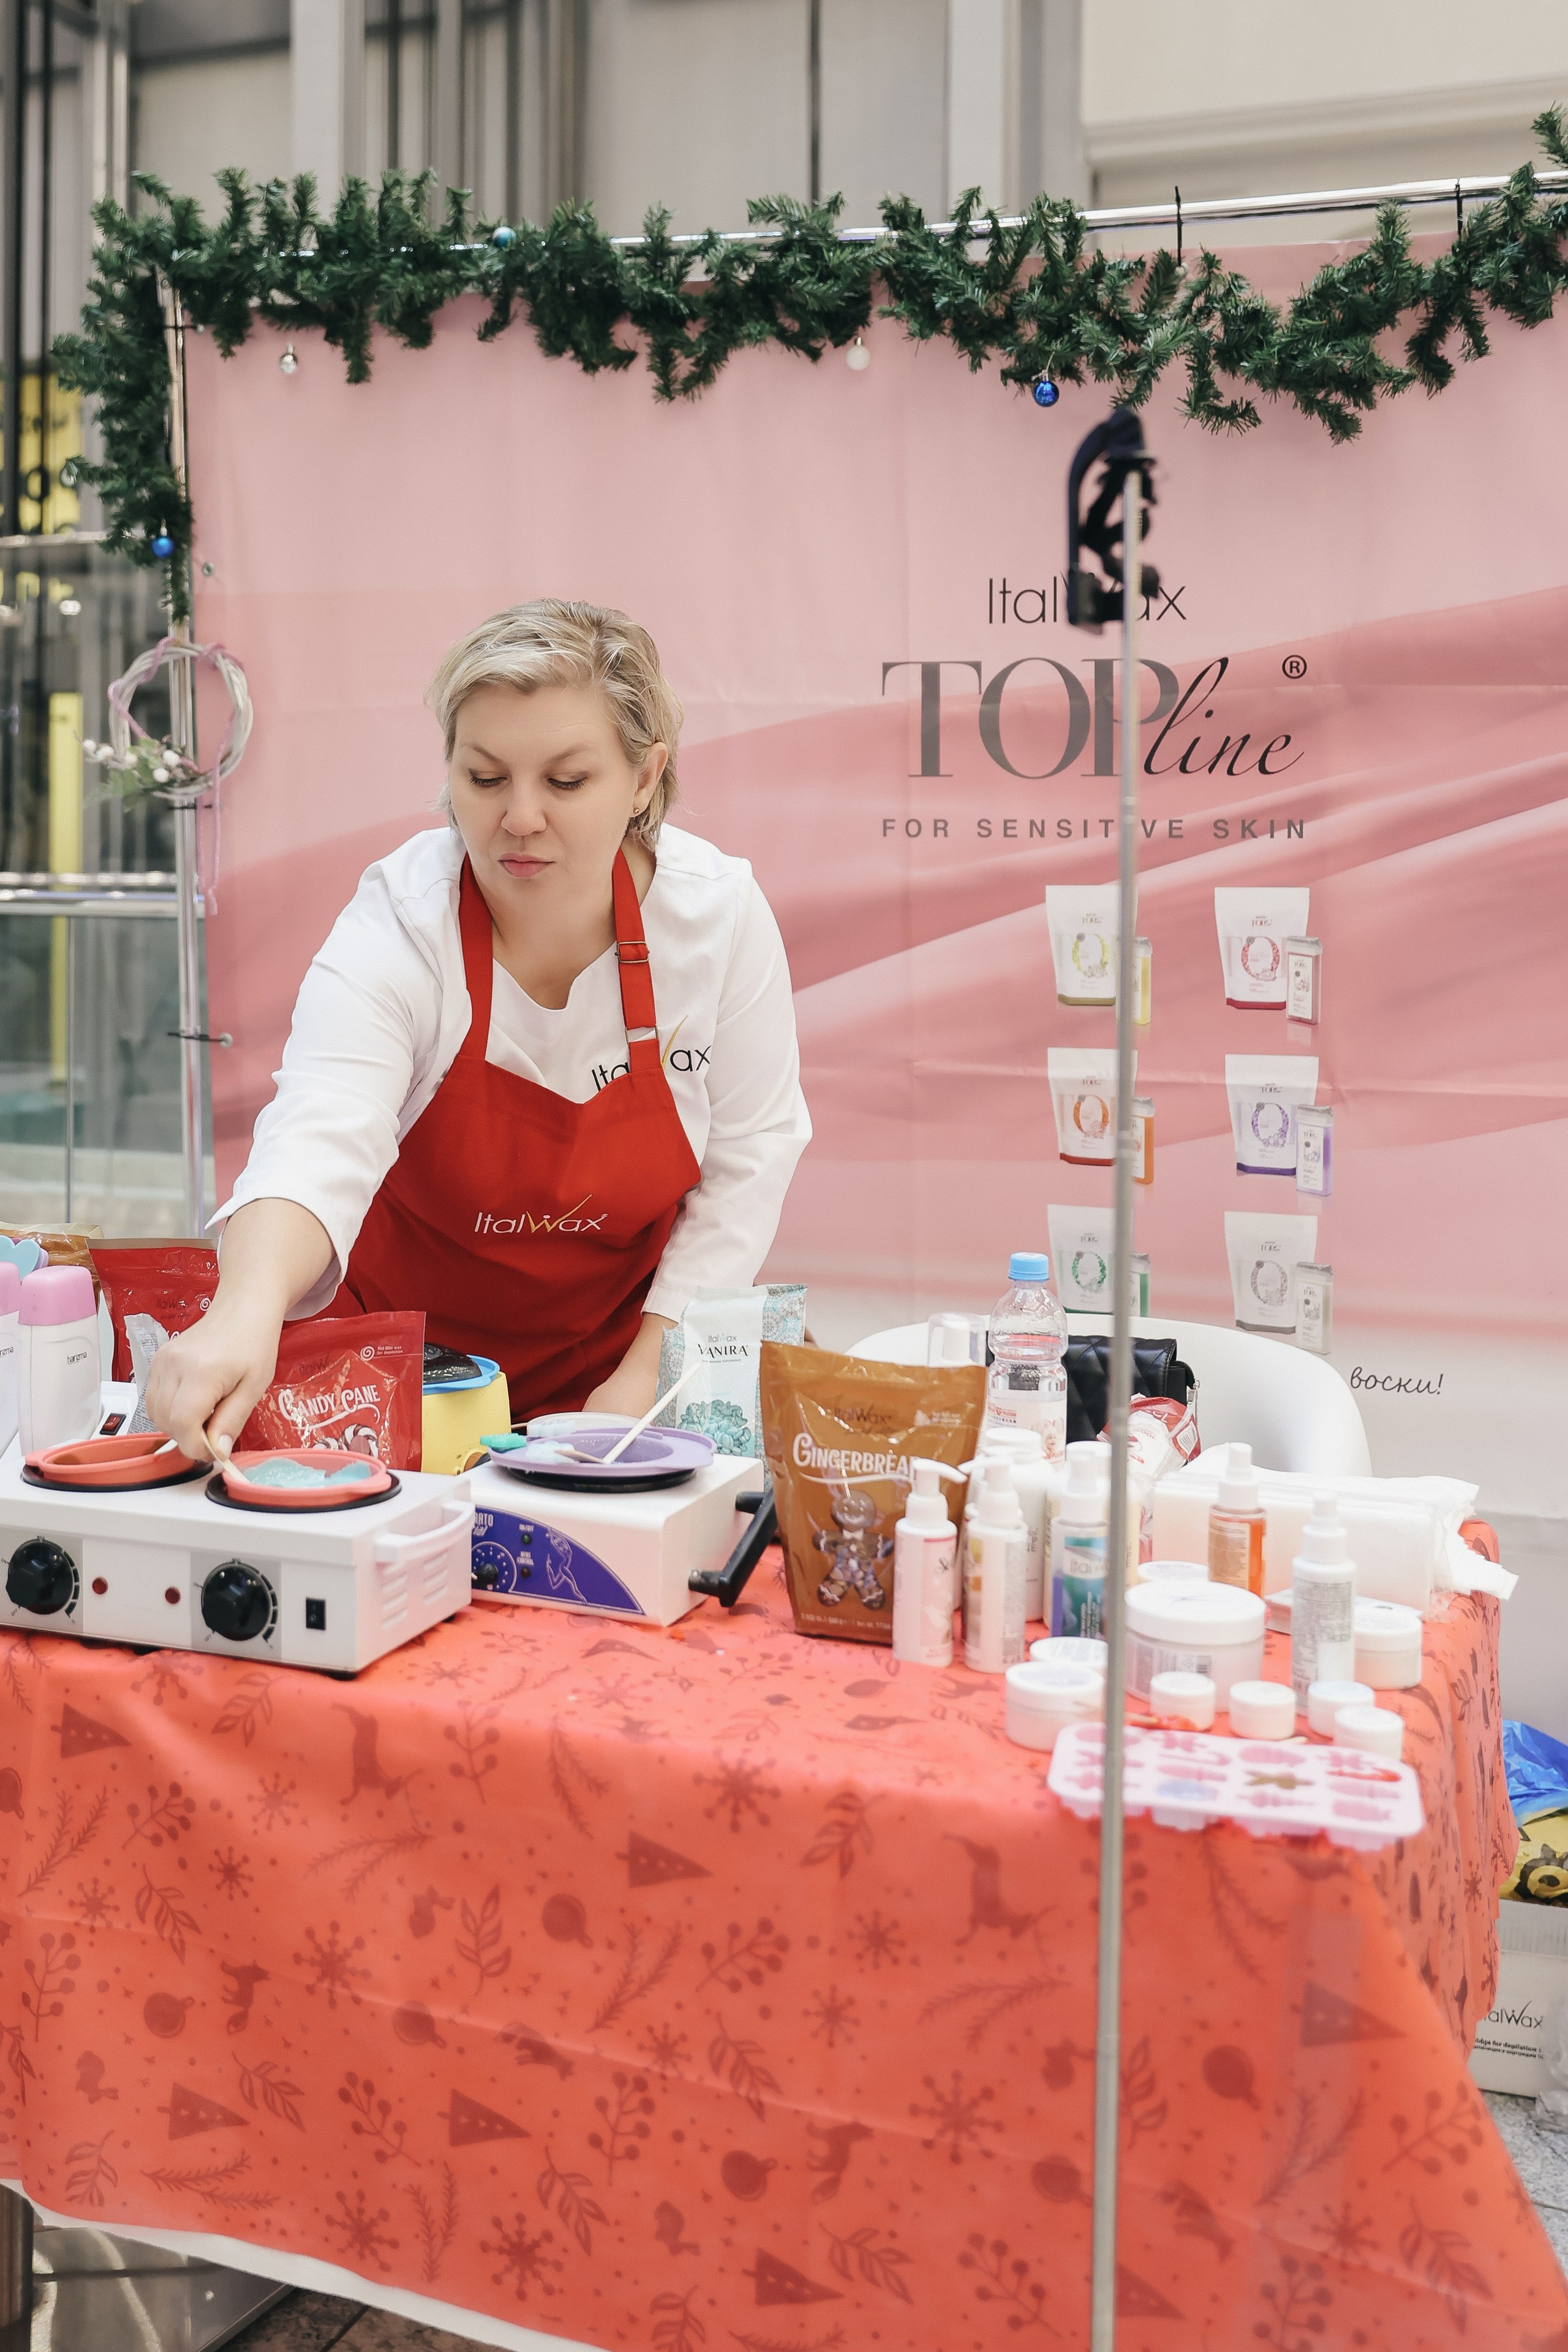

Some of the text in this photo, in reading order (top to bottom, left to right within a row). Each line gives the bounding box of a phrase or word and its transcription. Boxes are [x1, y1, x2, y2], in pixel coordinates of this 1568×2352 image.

[989, 571, 1186, 624] Italx
[882, 657, 1180, 779] TOP
[1144, 657, 1305, 776] line
[883, 818, 1305, 839] FOR SENSITVE SKIN
[474, 1194, 603, 1234] ItalWax
[697, 1343, 748, 1359] VANIRA
[1350, 1366, 1444, 1395] воски!
[278, 1384, 381, 1420] CANDY CANE
[1484, 2000, 1544, 2029] alWax
